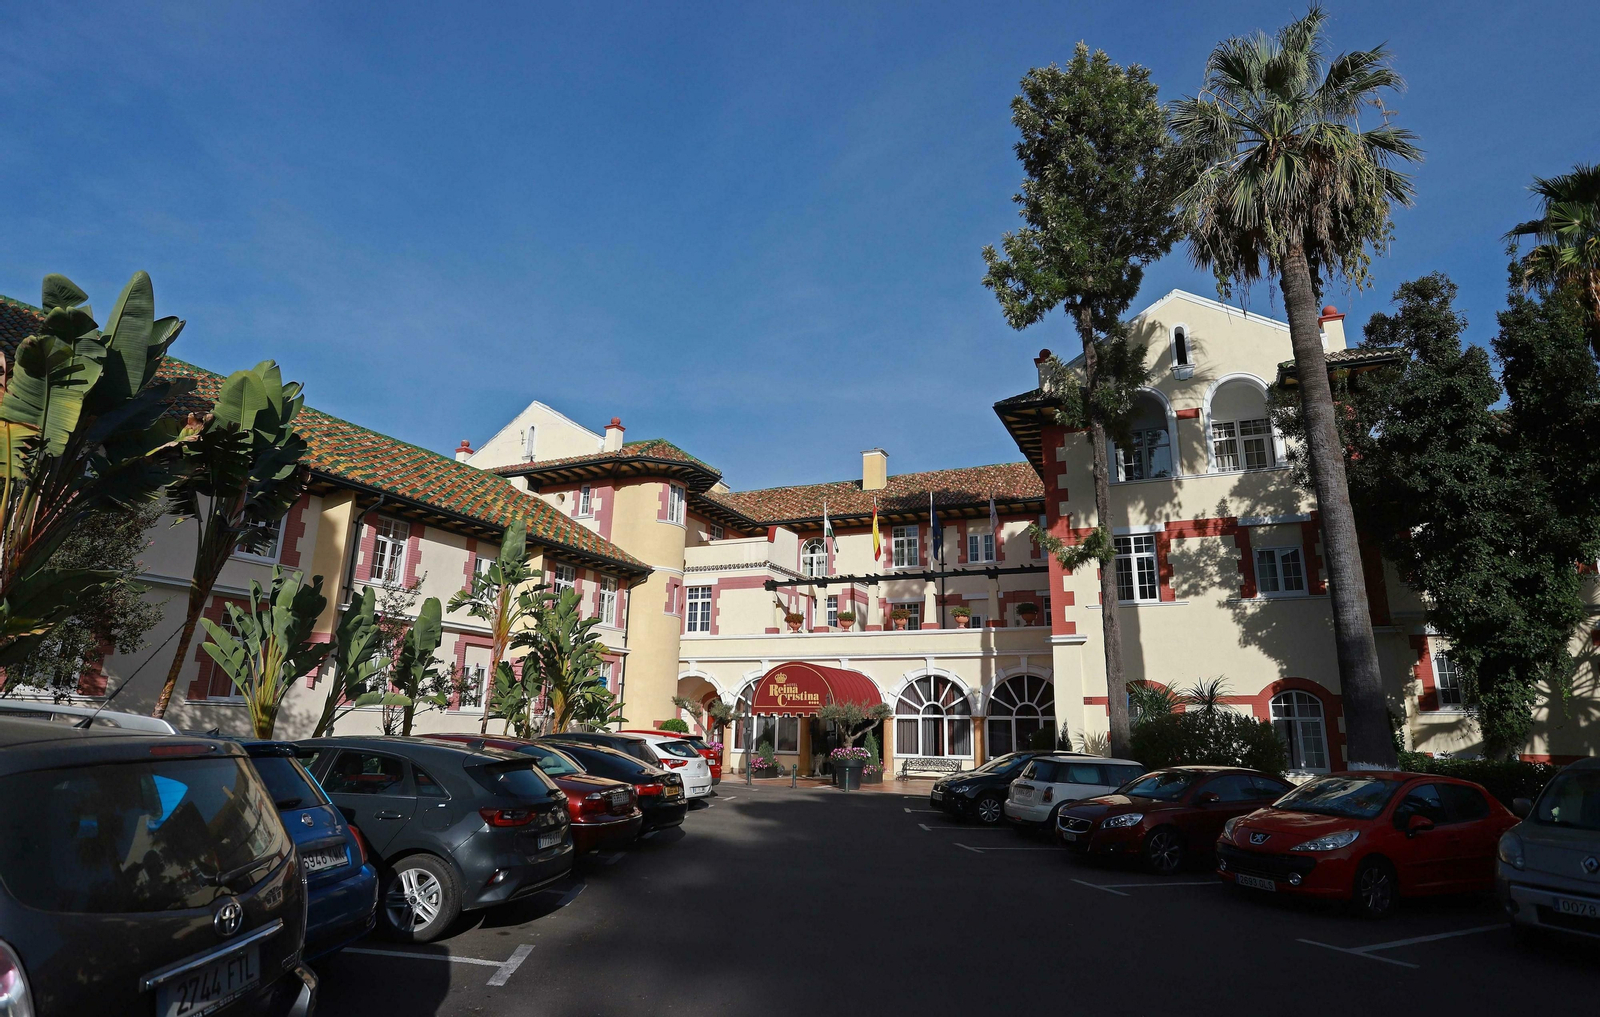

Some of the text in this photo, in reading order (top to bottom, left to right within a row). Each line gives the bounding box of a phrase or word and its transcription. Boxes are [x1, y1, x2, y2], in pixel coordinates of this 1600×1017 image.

[769, 684, 798, 697] Reina
[777, 691, 820, 707] Cristina
[302, 851, 327, 870] 6946
[1240, 875, 1258, 887] 2693
[1562, 900, 1597, 917] 0078
[177, 966, 222, 1016] 2744
[227, 953, 254, 990] FTL
